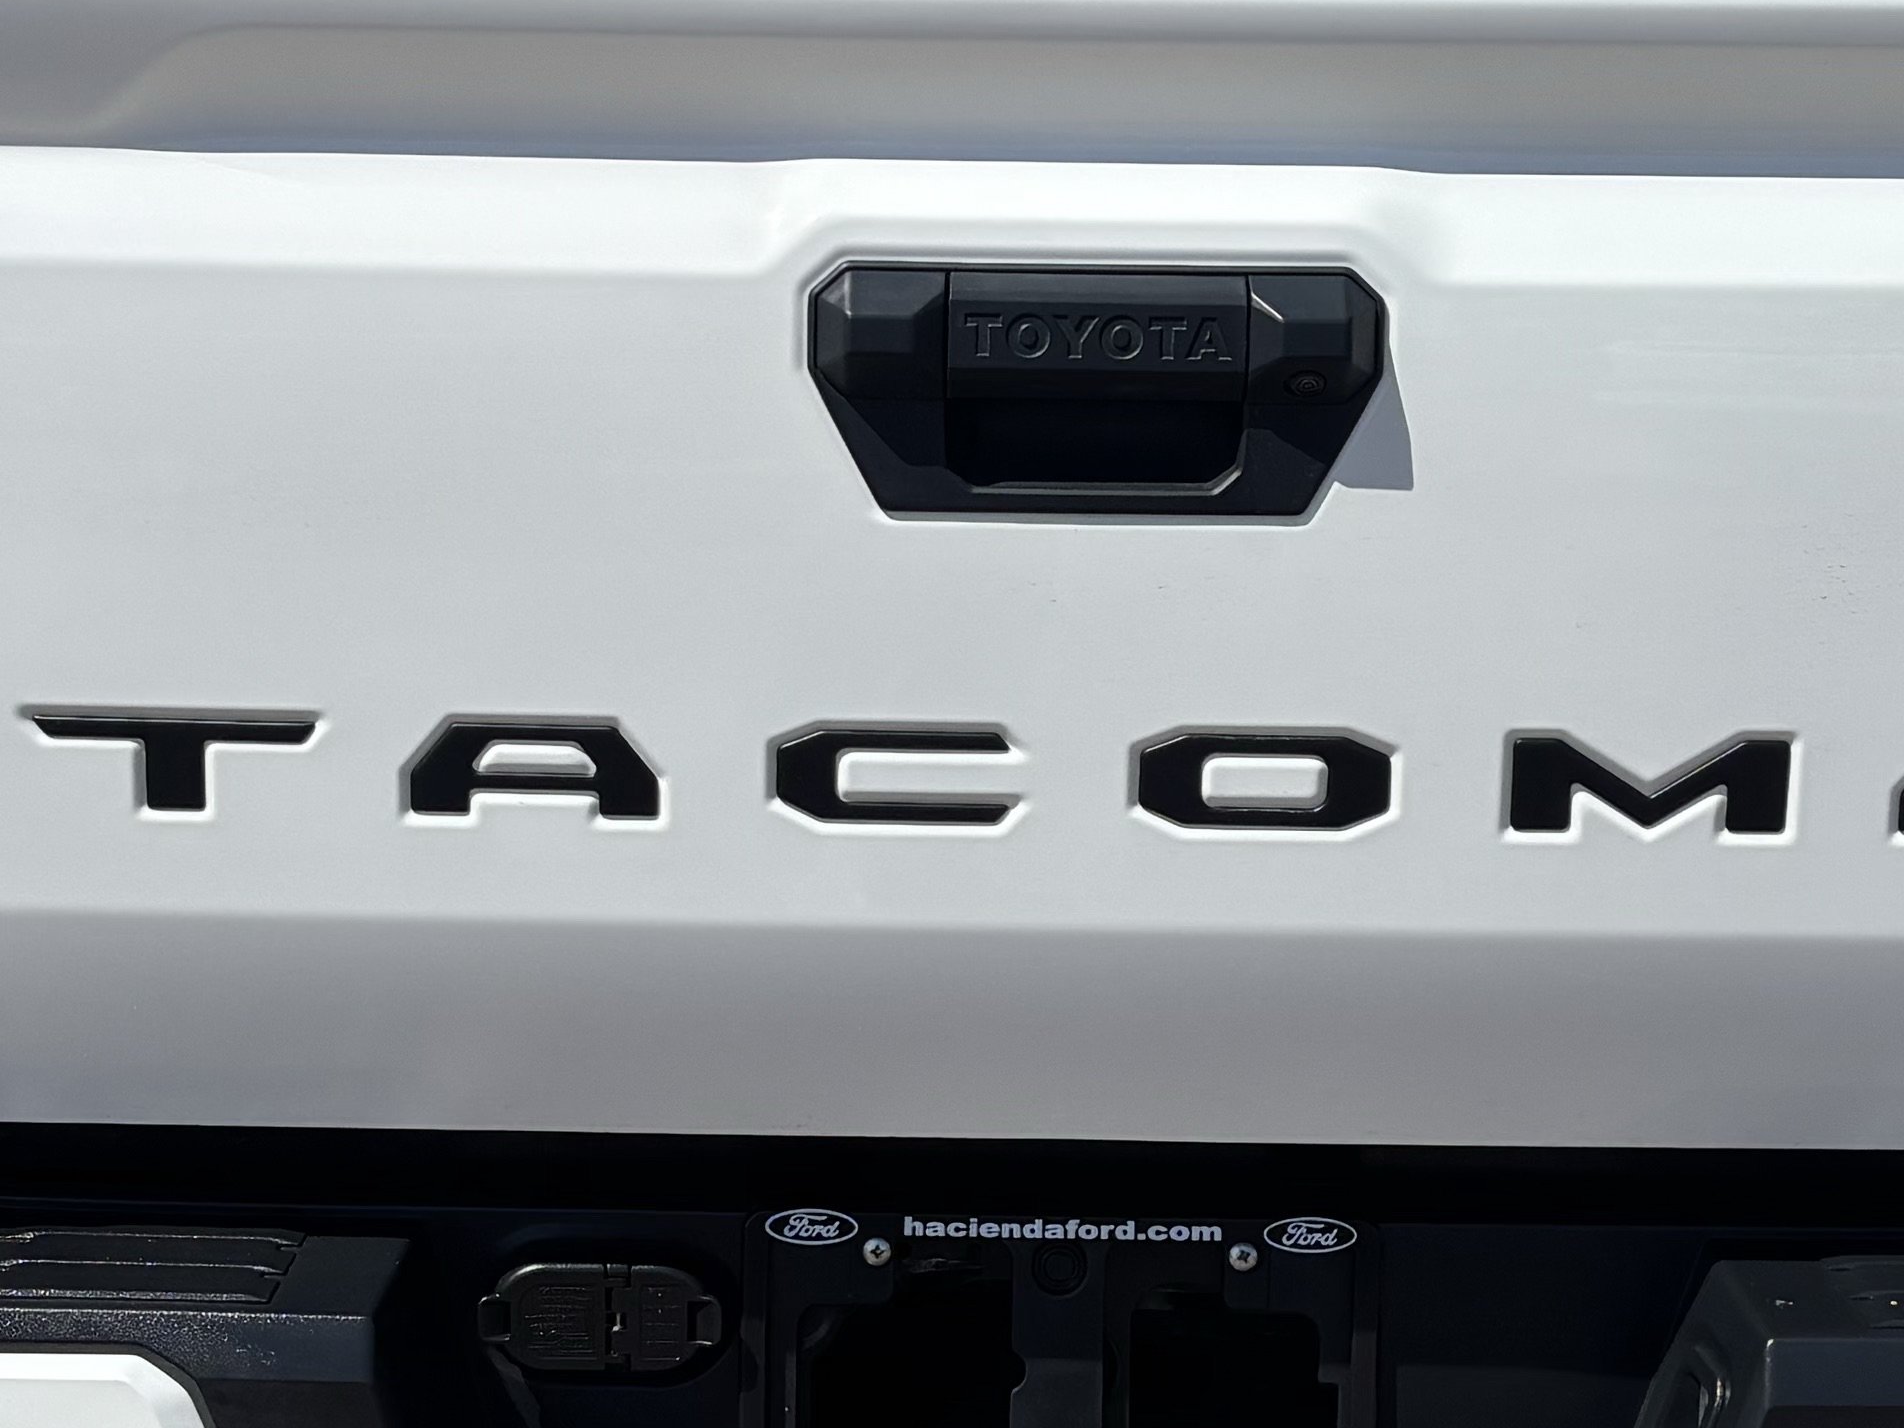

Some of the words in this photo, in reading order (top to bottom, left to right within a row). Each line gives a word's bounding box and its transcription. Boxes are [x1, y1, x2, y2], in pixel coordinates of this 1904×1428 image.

[964, 311, 1233, 362] TOYOTA
[783, 1213, 841, 1239] Ford
[903, 1215, 1223, 1243] haciendaford.com
[1281, 1218, 1339, 1247] Ford
